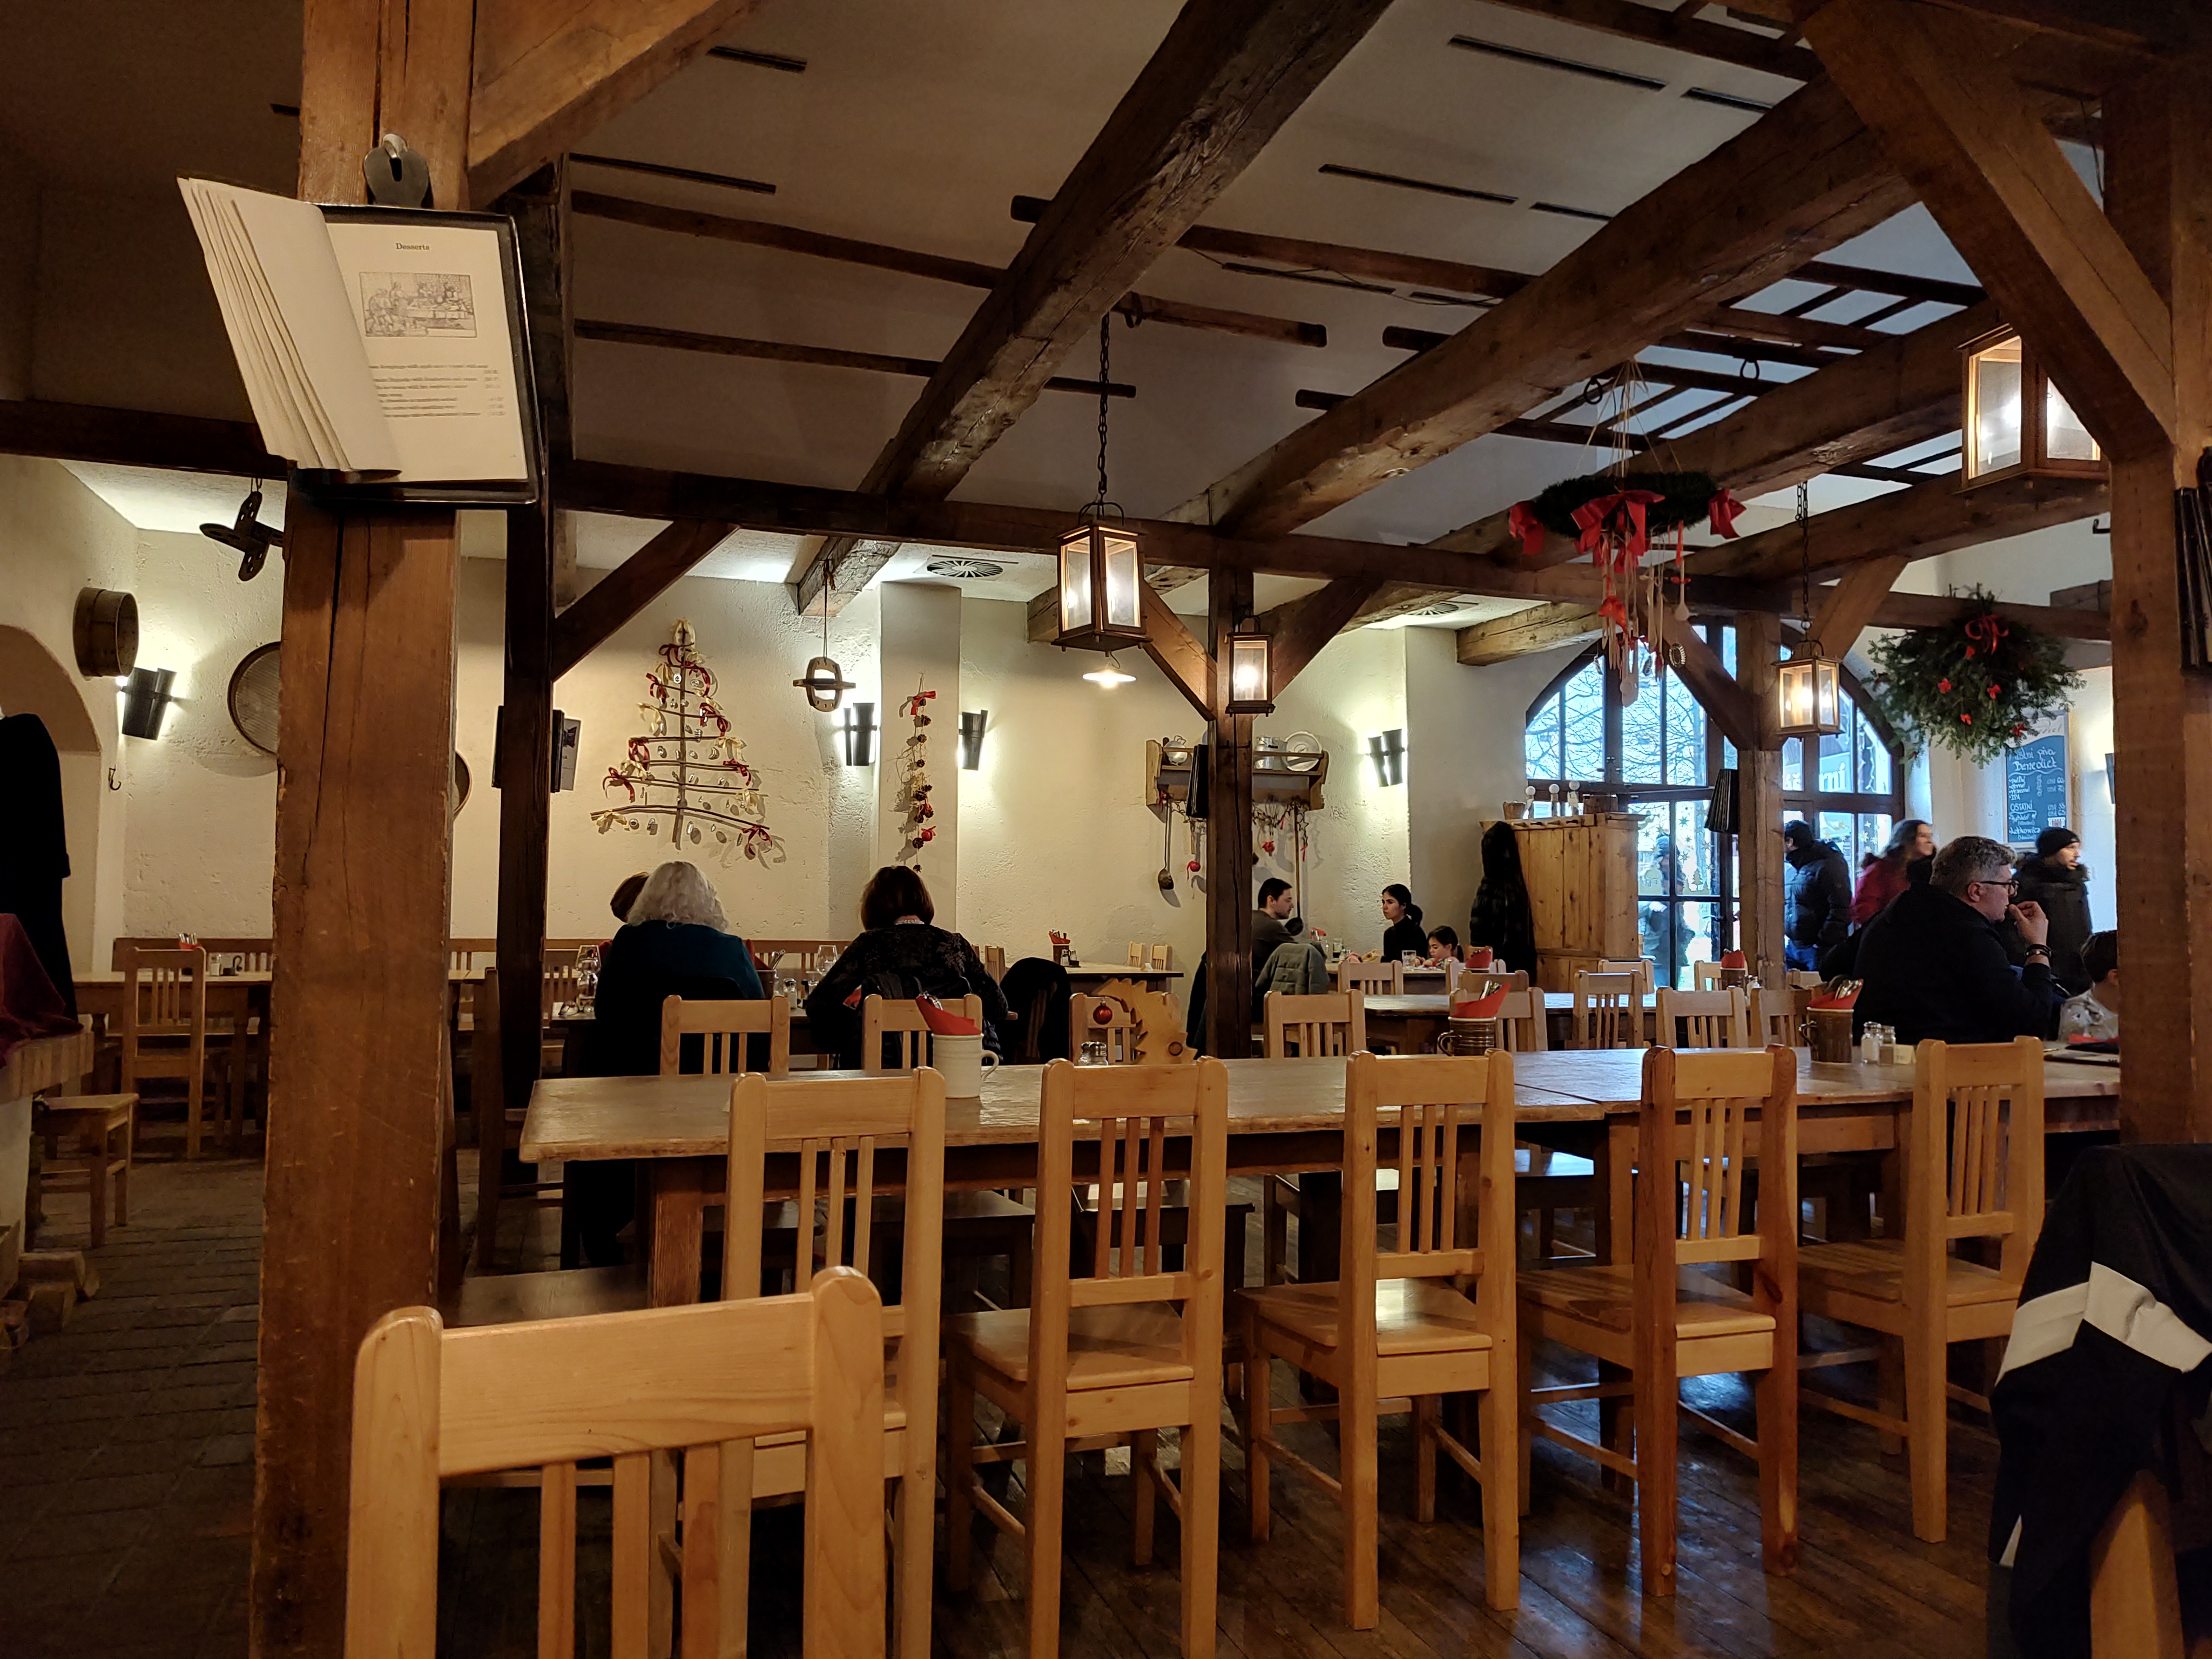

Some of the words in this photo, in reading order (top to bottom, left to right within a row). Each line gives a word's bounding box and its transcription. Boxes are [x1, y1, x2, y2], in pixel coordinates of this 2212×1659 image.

[395, 242, 430, 251] Desserts
[2036, 746, 2057, 760] piva
[2012, 757, 2058, 771] Benedict
